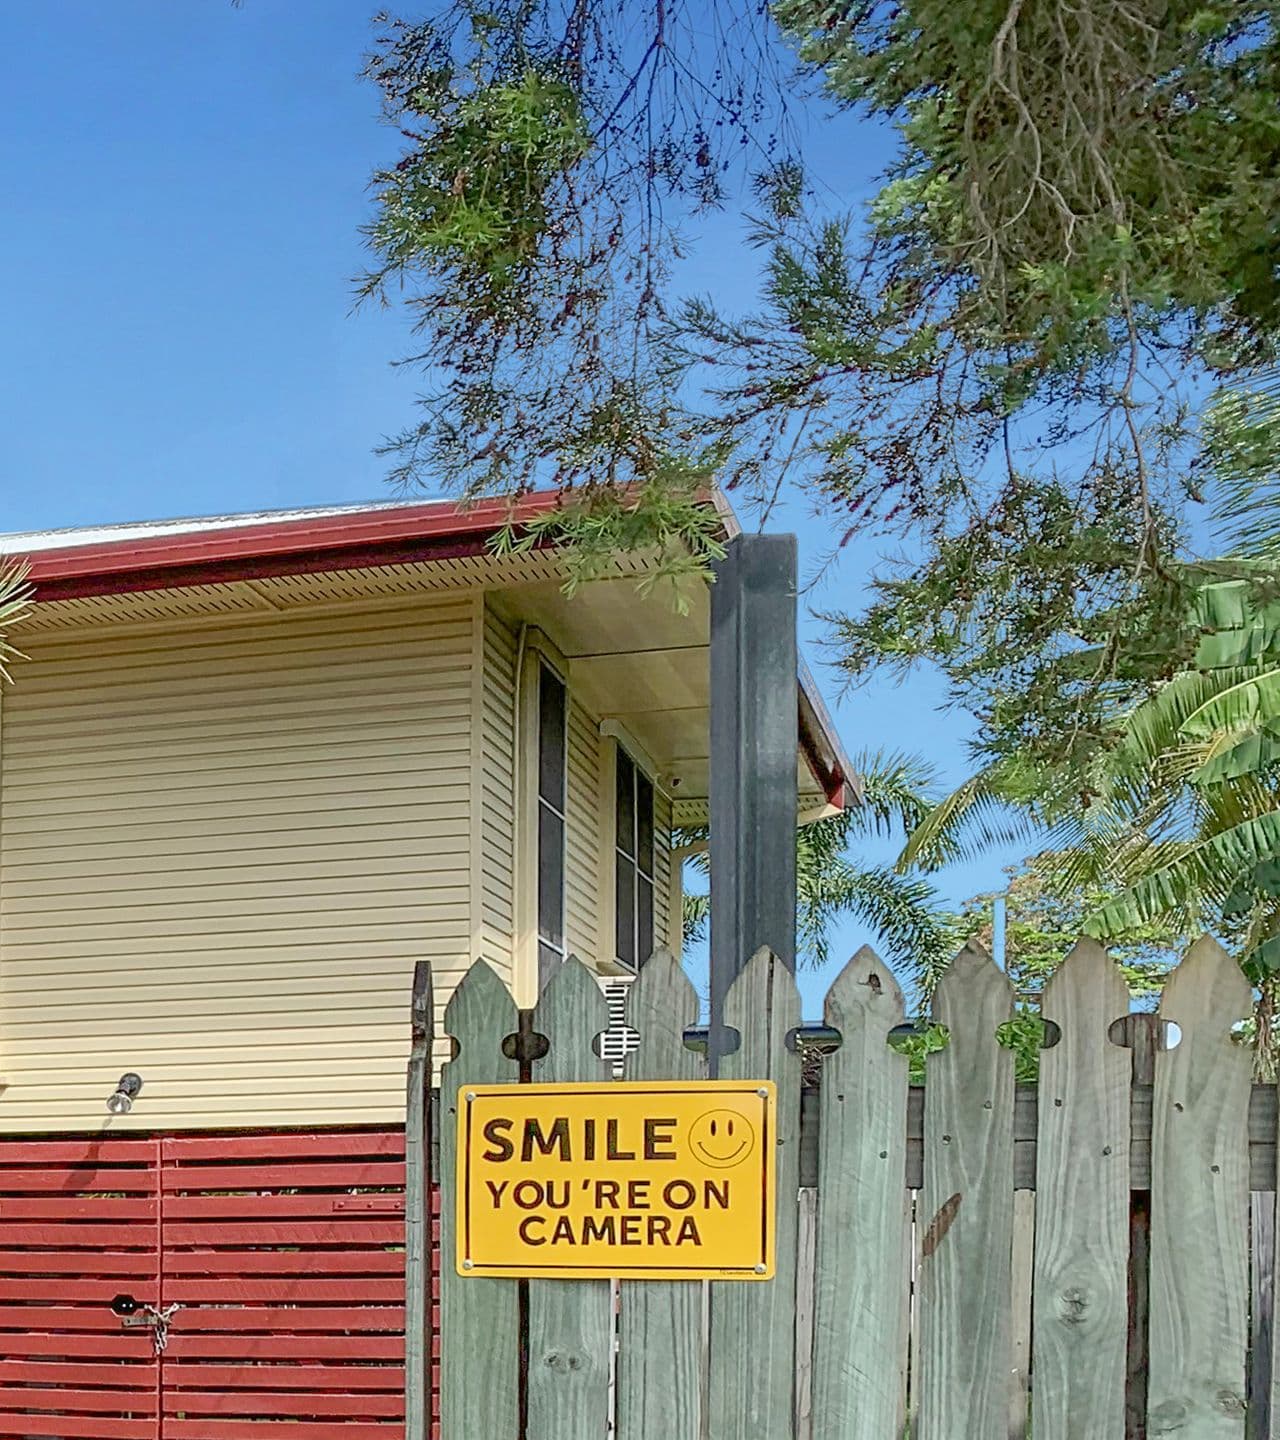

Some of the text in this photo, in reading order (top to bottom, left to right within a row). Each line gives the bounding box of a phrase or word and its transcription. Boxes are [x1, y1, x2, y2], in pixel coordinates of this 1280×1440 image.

[482, 1117, 678, 1163] SMILE
[485, 1178, 730, 1210] YOU'RE ON
[518, 1215, 703, 1247] CAMERA
